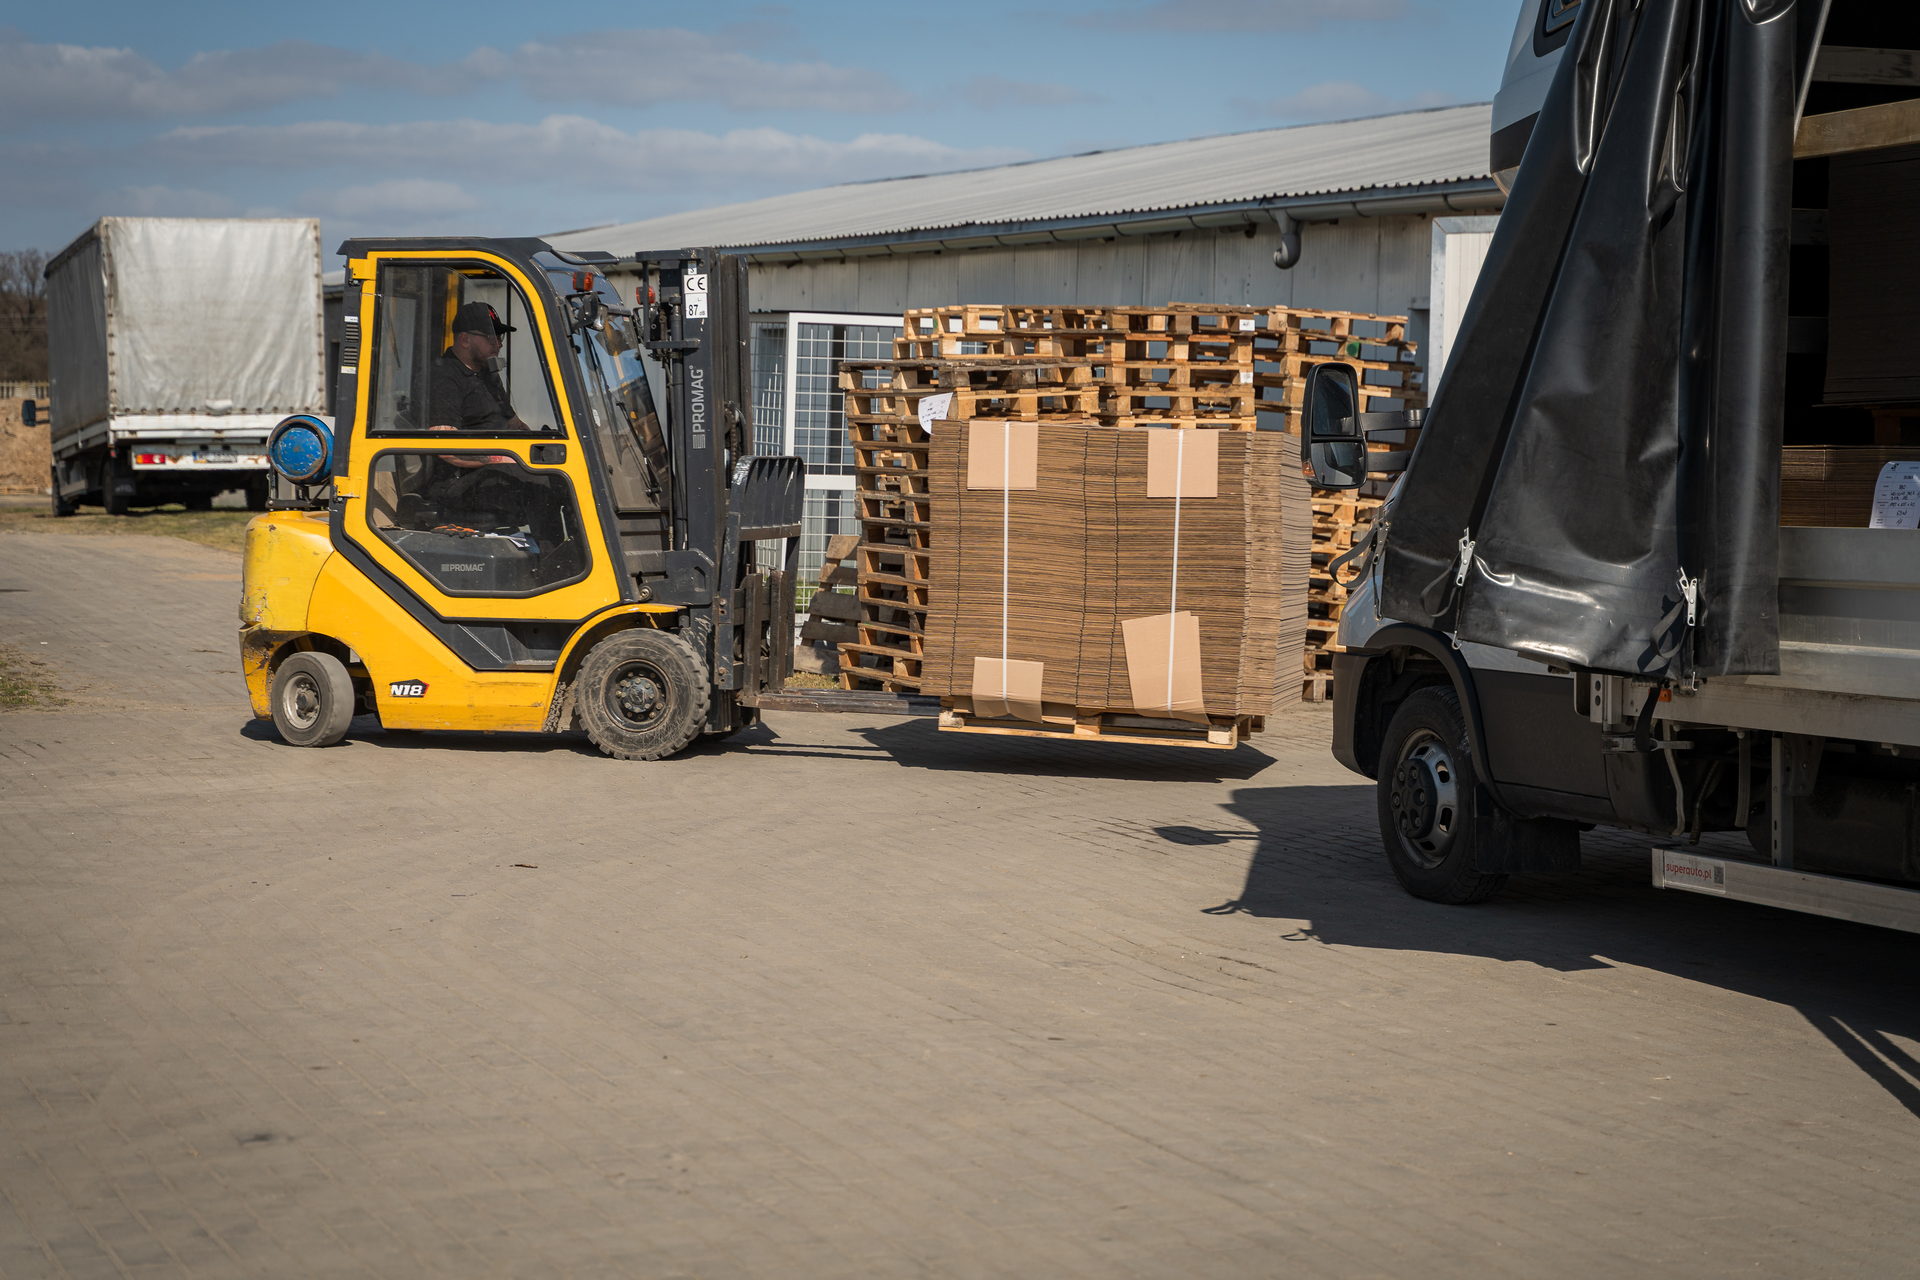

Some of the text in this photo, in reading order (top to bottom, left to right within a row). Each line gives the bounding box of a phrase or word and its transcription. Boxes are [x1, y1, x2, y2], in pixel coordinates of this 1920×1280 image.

[686, 276, 706, 292] CE
[688, 304, 699, 317] 87
[690, 369, 705, 433] PROMAG
[450, 563, 483, 572] PROMAG
[391, 684, 423, 696] N18
[1665, 863, 1712, 881] superauto.pl
